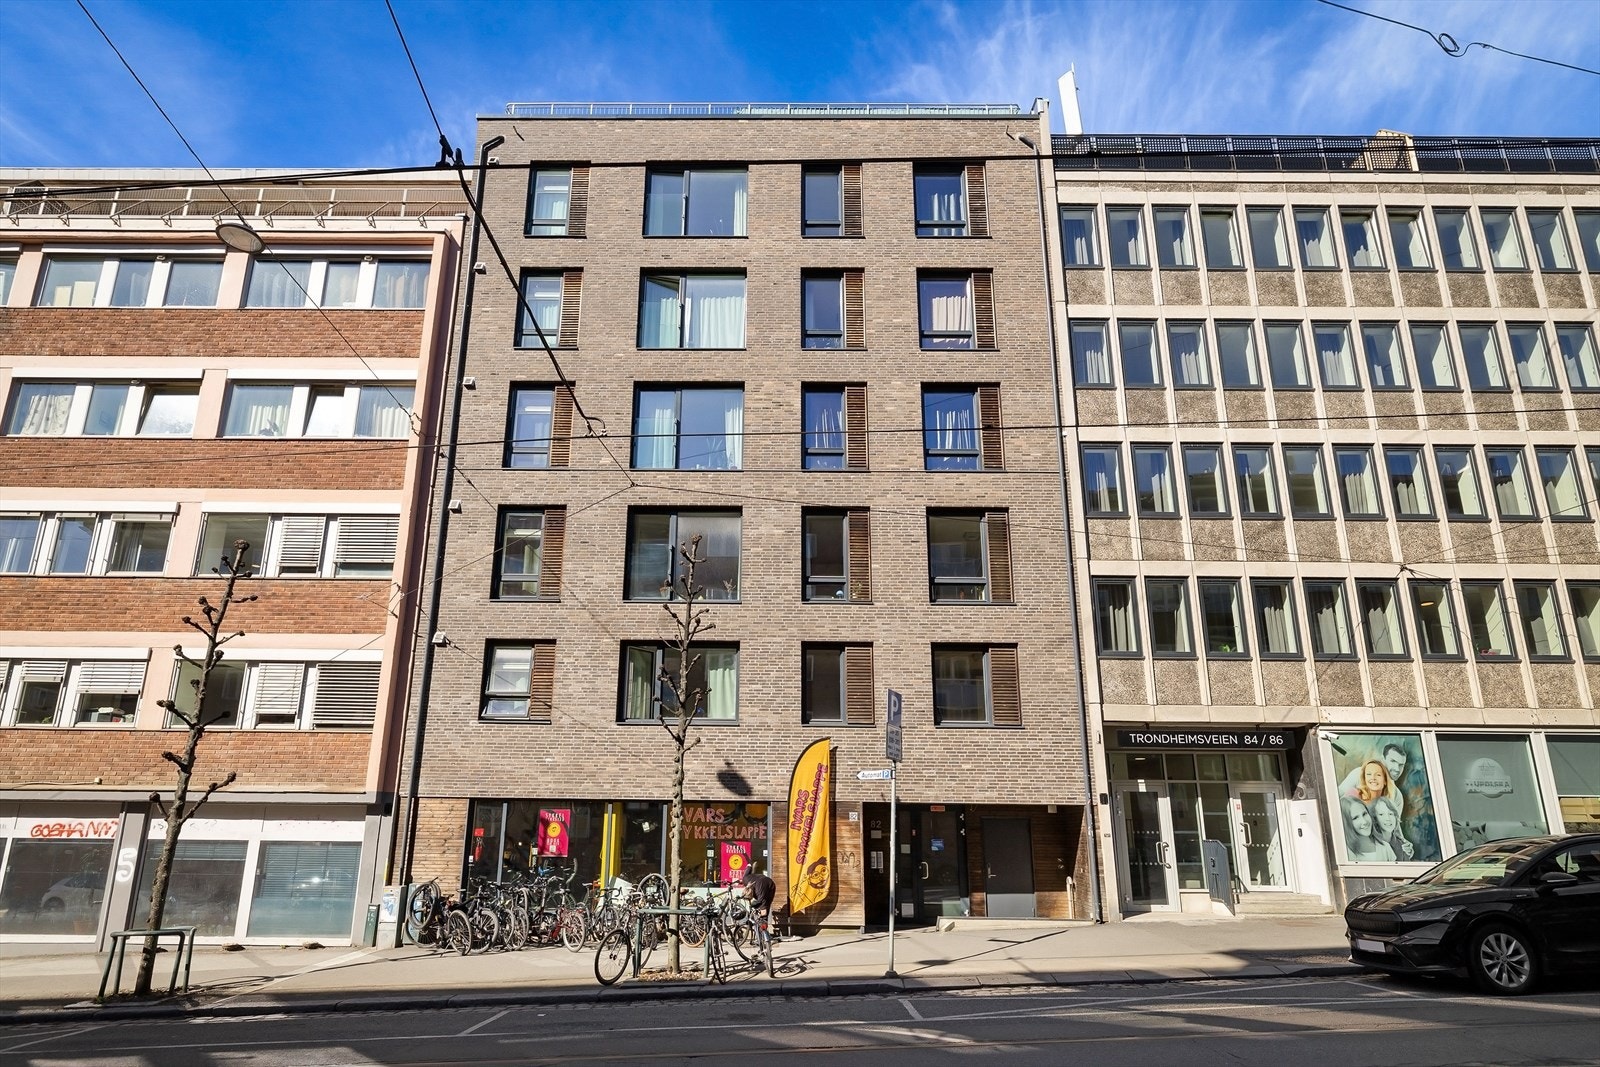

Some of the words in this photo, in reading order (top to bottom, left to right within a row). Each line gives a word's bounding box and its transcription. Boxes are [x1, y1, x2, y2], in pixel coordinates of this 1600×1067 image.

[890, 694, 899, 721] P
[1129, 733, 1238, 745] TRONDHEIMSVEIEN
[1244, 735, 1258, 745] 84
[1269, 735, 1284, 745] 86
[683, 807, 725, 824] VARS
[790, 789, 809, 831] IVARS
[870, 820, 882, 829] 82
[115, 847, 137, 883] 5
